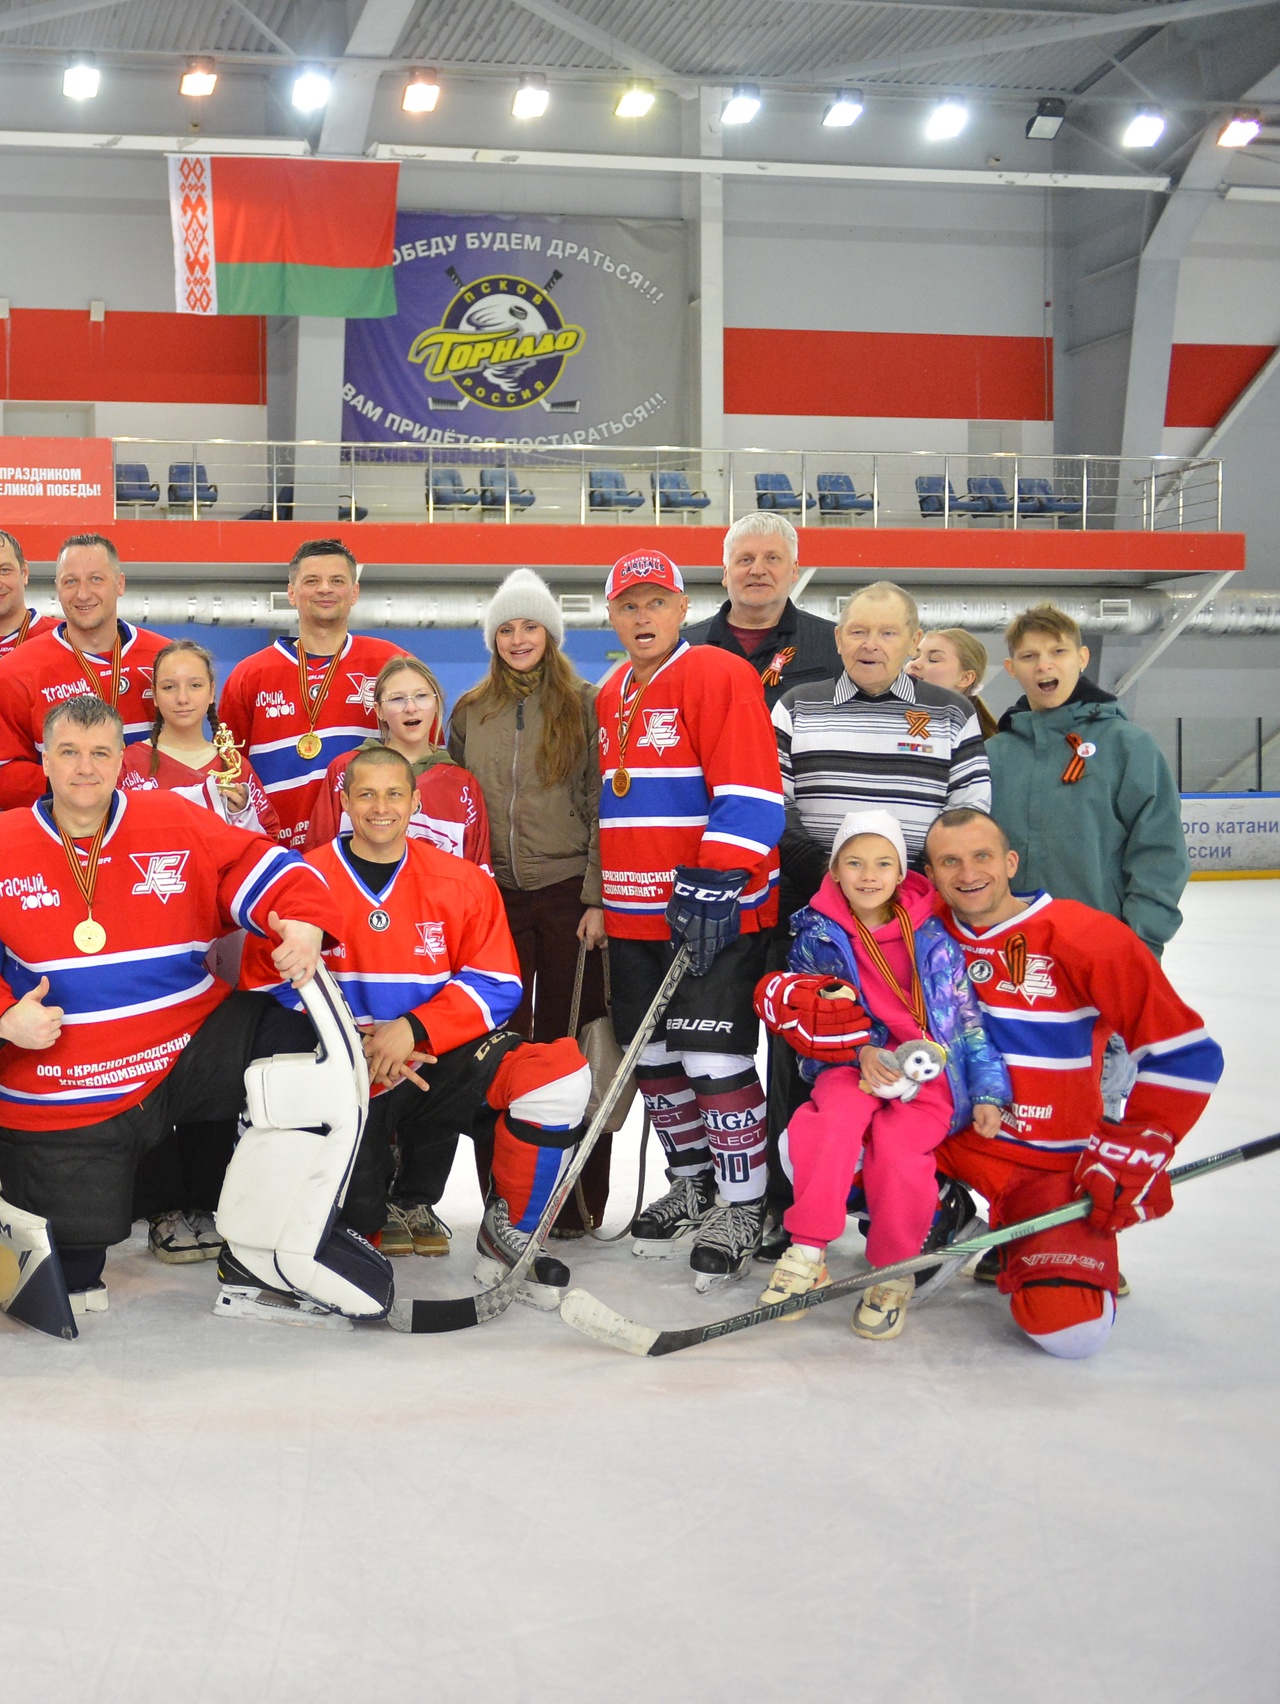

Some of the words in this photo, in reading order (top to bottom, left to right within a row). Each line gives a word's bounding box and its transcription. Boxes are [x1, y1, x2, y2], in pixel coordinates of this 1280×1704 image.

[392, 234, 458, 267] ОБЕДУ
[465, 232, 542, 252] БУДЕМ
[546, 239, 665, 304] ДРАТЬСЯ!!!
[463, 280, 543, 305] ПСКОВ
[462, 377, 546, 403] РОССИЯ
[342, 382, 384, 422] ВАМ
[384, 412, 497, 453] ПРИДЁТСЯ
[0, 466, 82, 482] ПРАЗДНИКОМ
[46, 482, 102, 498] ПОБЕДЫ!
[1216, 821, 1280, 834] катани
[1187, 845, 1233, 859] ссии
[674, 881, 743, 902] CCM
[665, 1018, 734, 1034] BAUER
[36, 1064, 62, 1077] ООО
[708, 1128, 762, 1146] ELECT
[1087, 1133, 1166, 1170] CCM
[716, 1152, 750, 1183] 10
